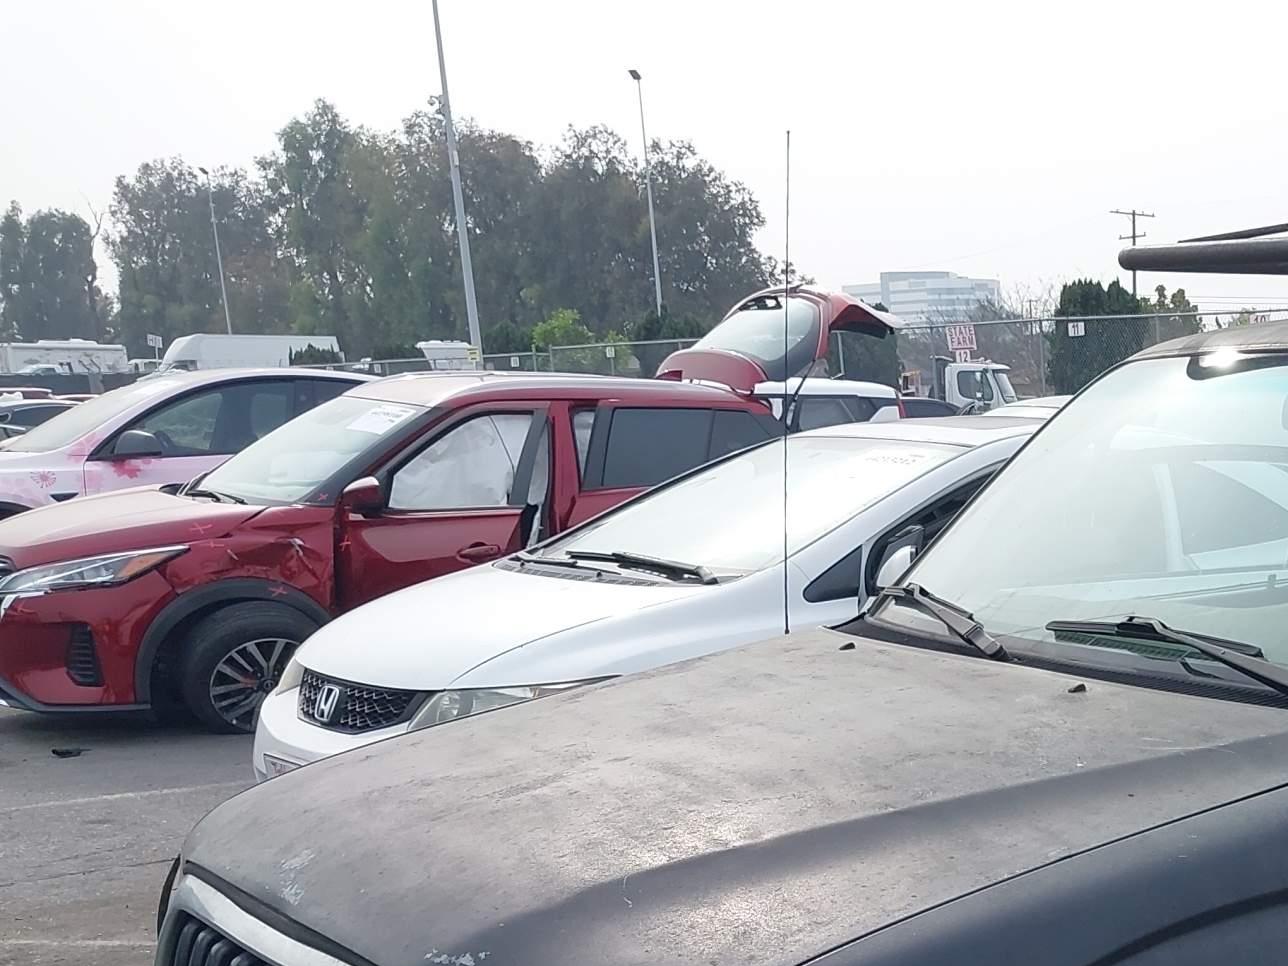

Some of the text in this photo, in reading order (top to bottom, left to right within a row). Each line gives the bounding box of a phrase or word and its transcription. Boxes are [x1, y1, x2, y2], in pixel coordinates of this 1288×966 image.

[947, 326, 975, 337] STATE
[1071, 323, 1079, 335] 11
[951, 336, 976, 348] FARM
[958, 351, 969, 363] 12
